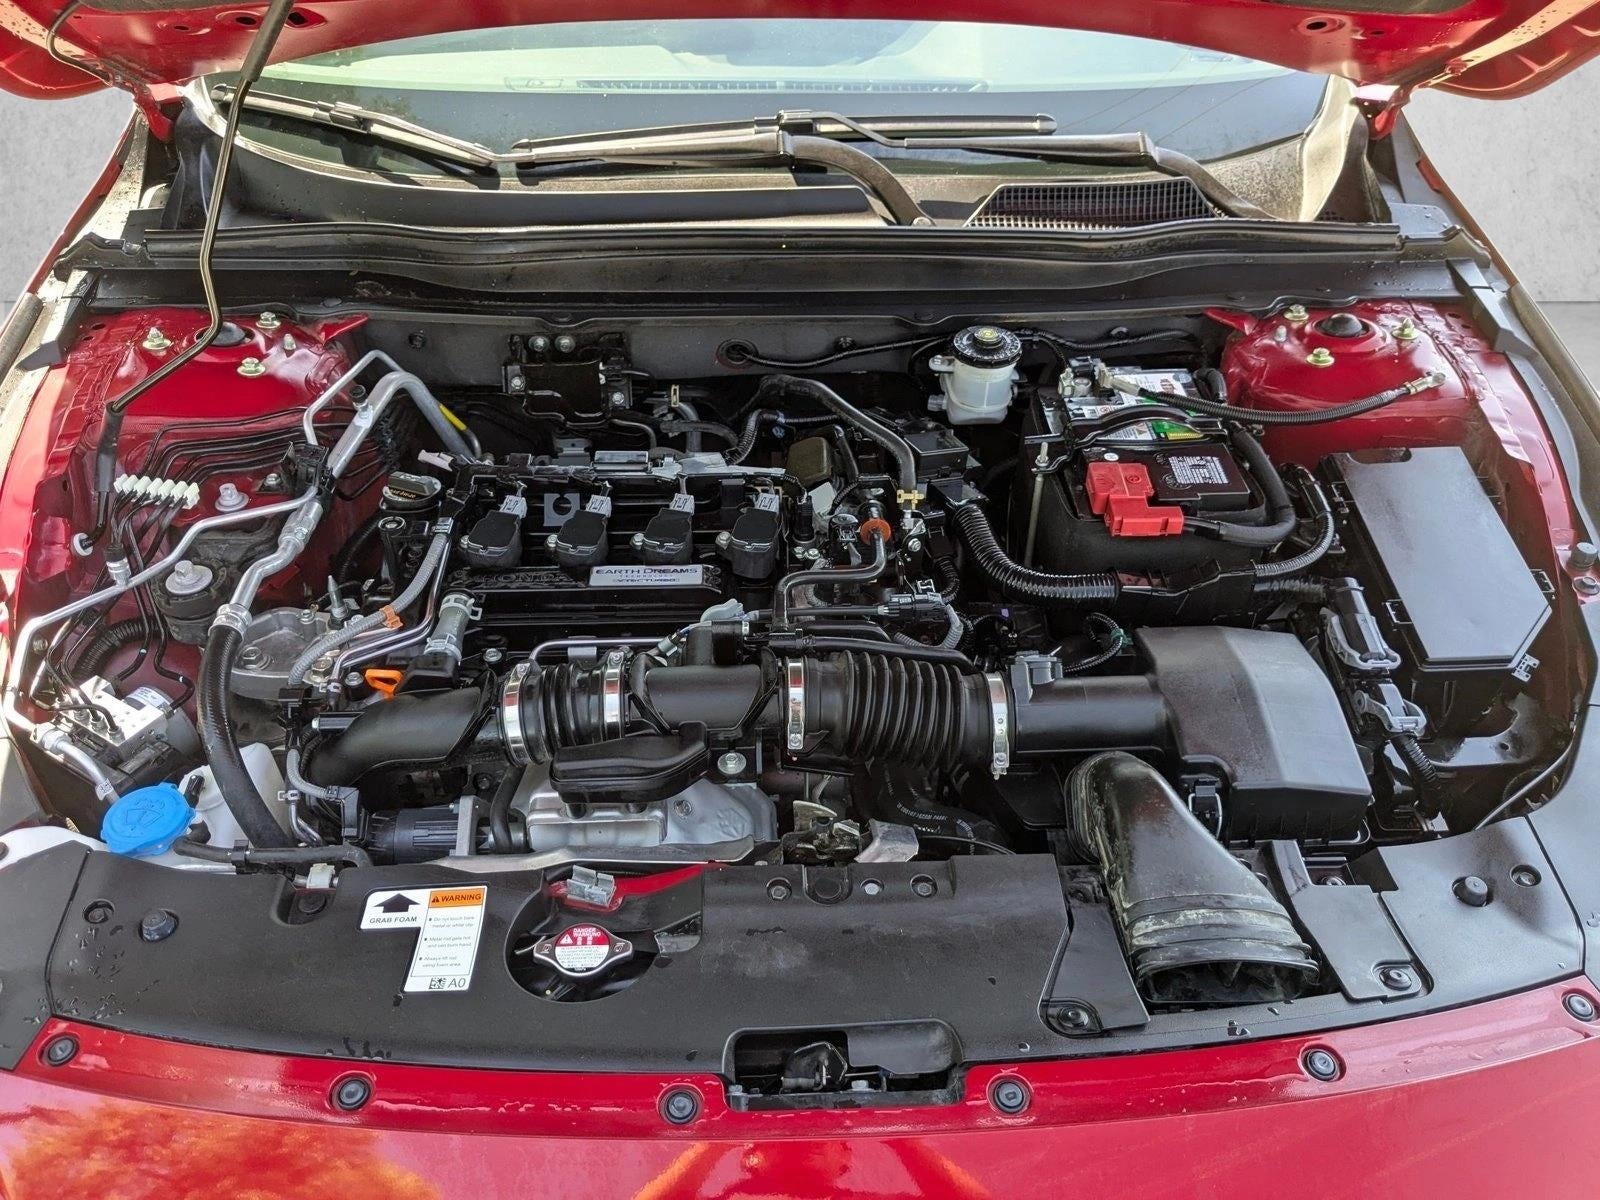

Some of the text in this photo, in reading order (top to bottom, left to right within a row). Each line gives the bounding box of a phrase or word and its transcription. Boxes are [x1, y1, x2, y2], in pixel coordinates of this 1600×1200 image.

[596, 567, 698, 576] EARTH DREAMS
[441, 893, 482, 902] WARNING
